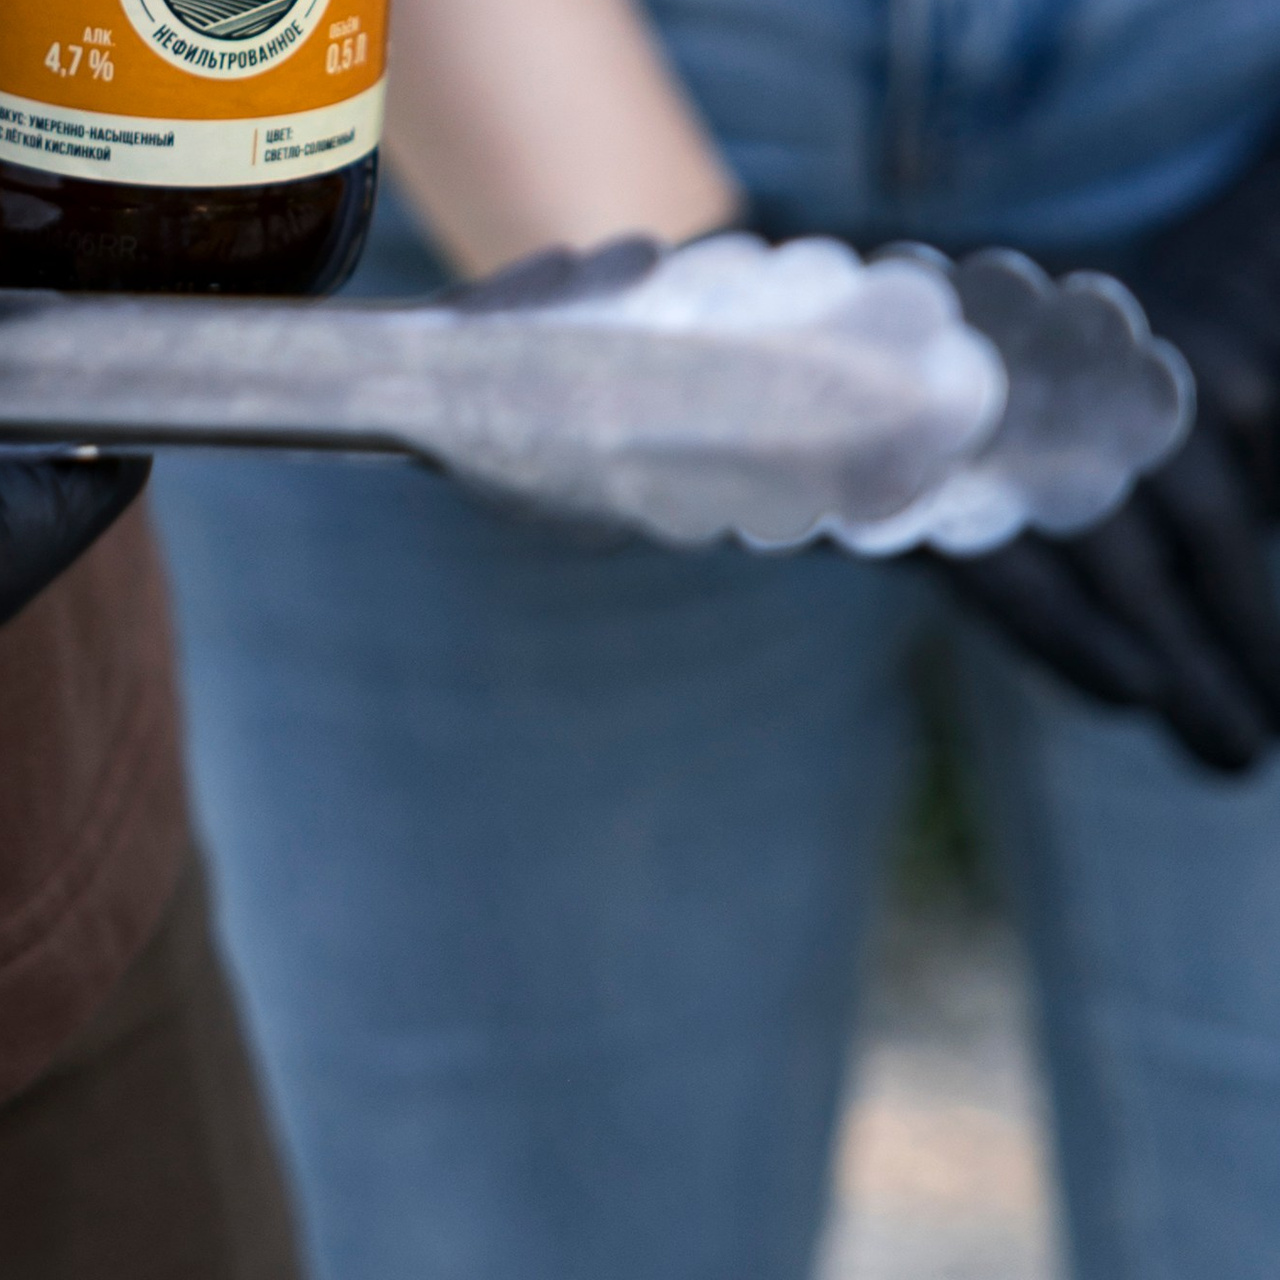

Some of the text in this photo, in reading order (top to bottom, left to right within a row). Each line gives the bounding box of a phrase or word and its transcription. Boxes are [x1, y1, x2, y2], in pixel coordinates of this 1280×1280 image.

[83, 26, 116, 47] АЛК.
[152, 18, 305, 71] НЕФИЛЬТРОВАННОЕ
[5, 127, 43, 150] ЛЁГКОЙ
[45, 137, 112, 161] КИСЛИНКОЙ
[28, 114, 175, 147] УМЕРЕННО-НАСЫЩЕННЫЙ
